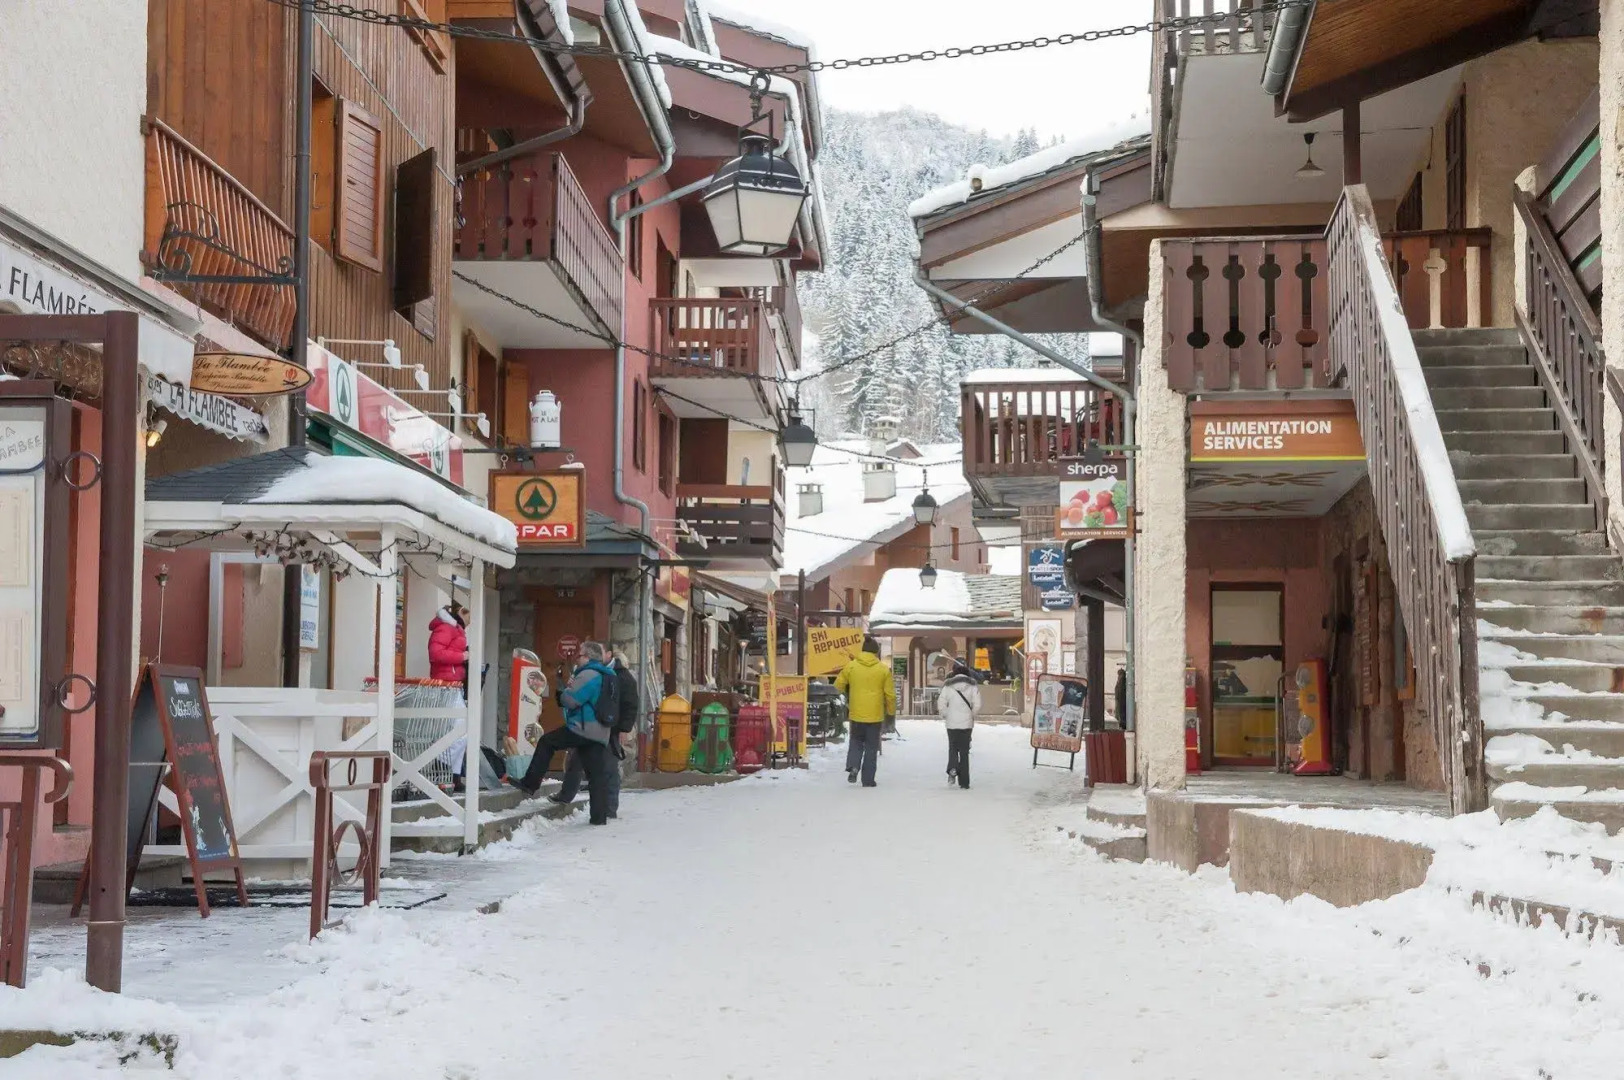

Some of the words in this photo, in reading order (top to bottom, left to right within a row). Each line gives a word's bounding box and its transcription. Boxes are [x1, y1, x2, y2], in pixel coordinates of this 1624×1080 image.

[194, 357, 211, 370] La
[170, 383, 184, 410] LA
[188, 388, 238, 432] FLAMBEE
[1204, 421, 1332, 435] ALIMENTATION
[1204, 436, 1284, 449] SERVICES
[1067, 462, 1118, 476] sherpa
[811, 631, 828, 643] SKI
